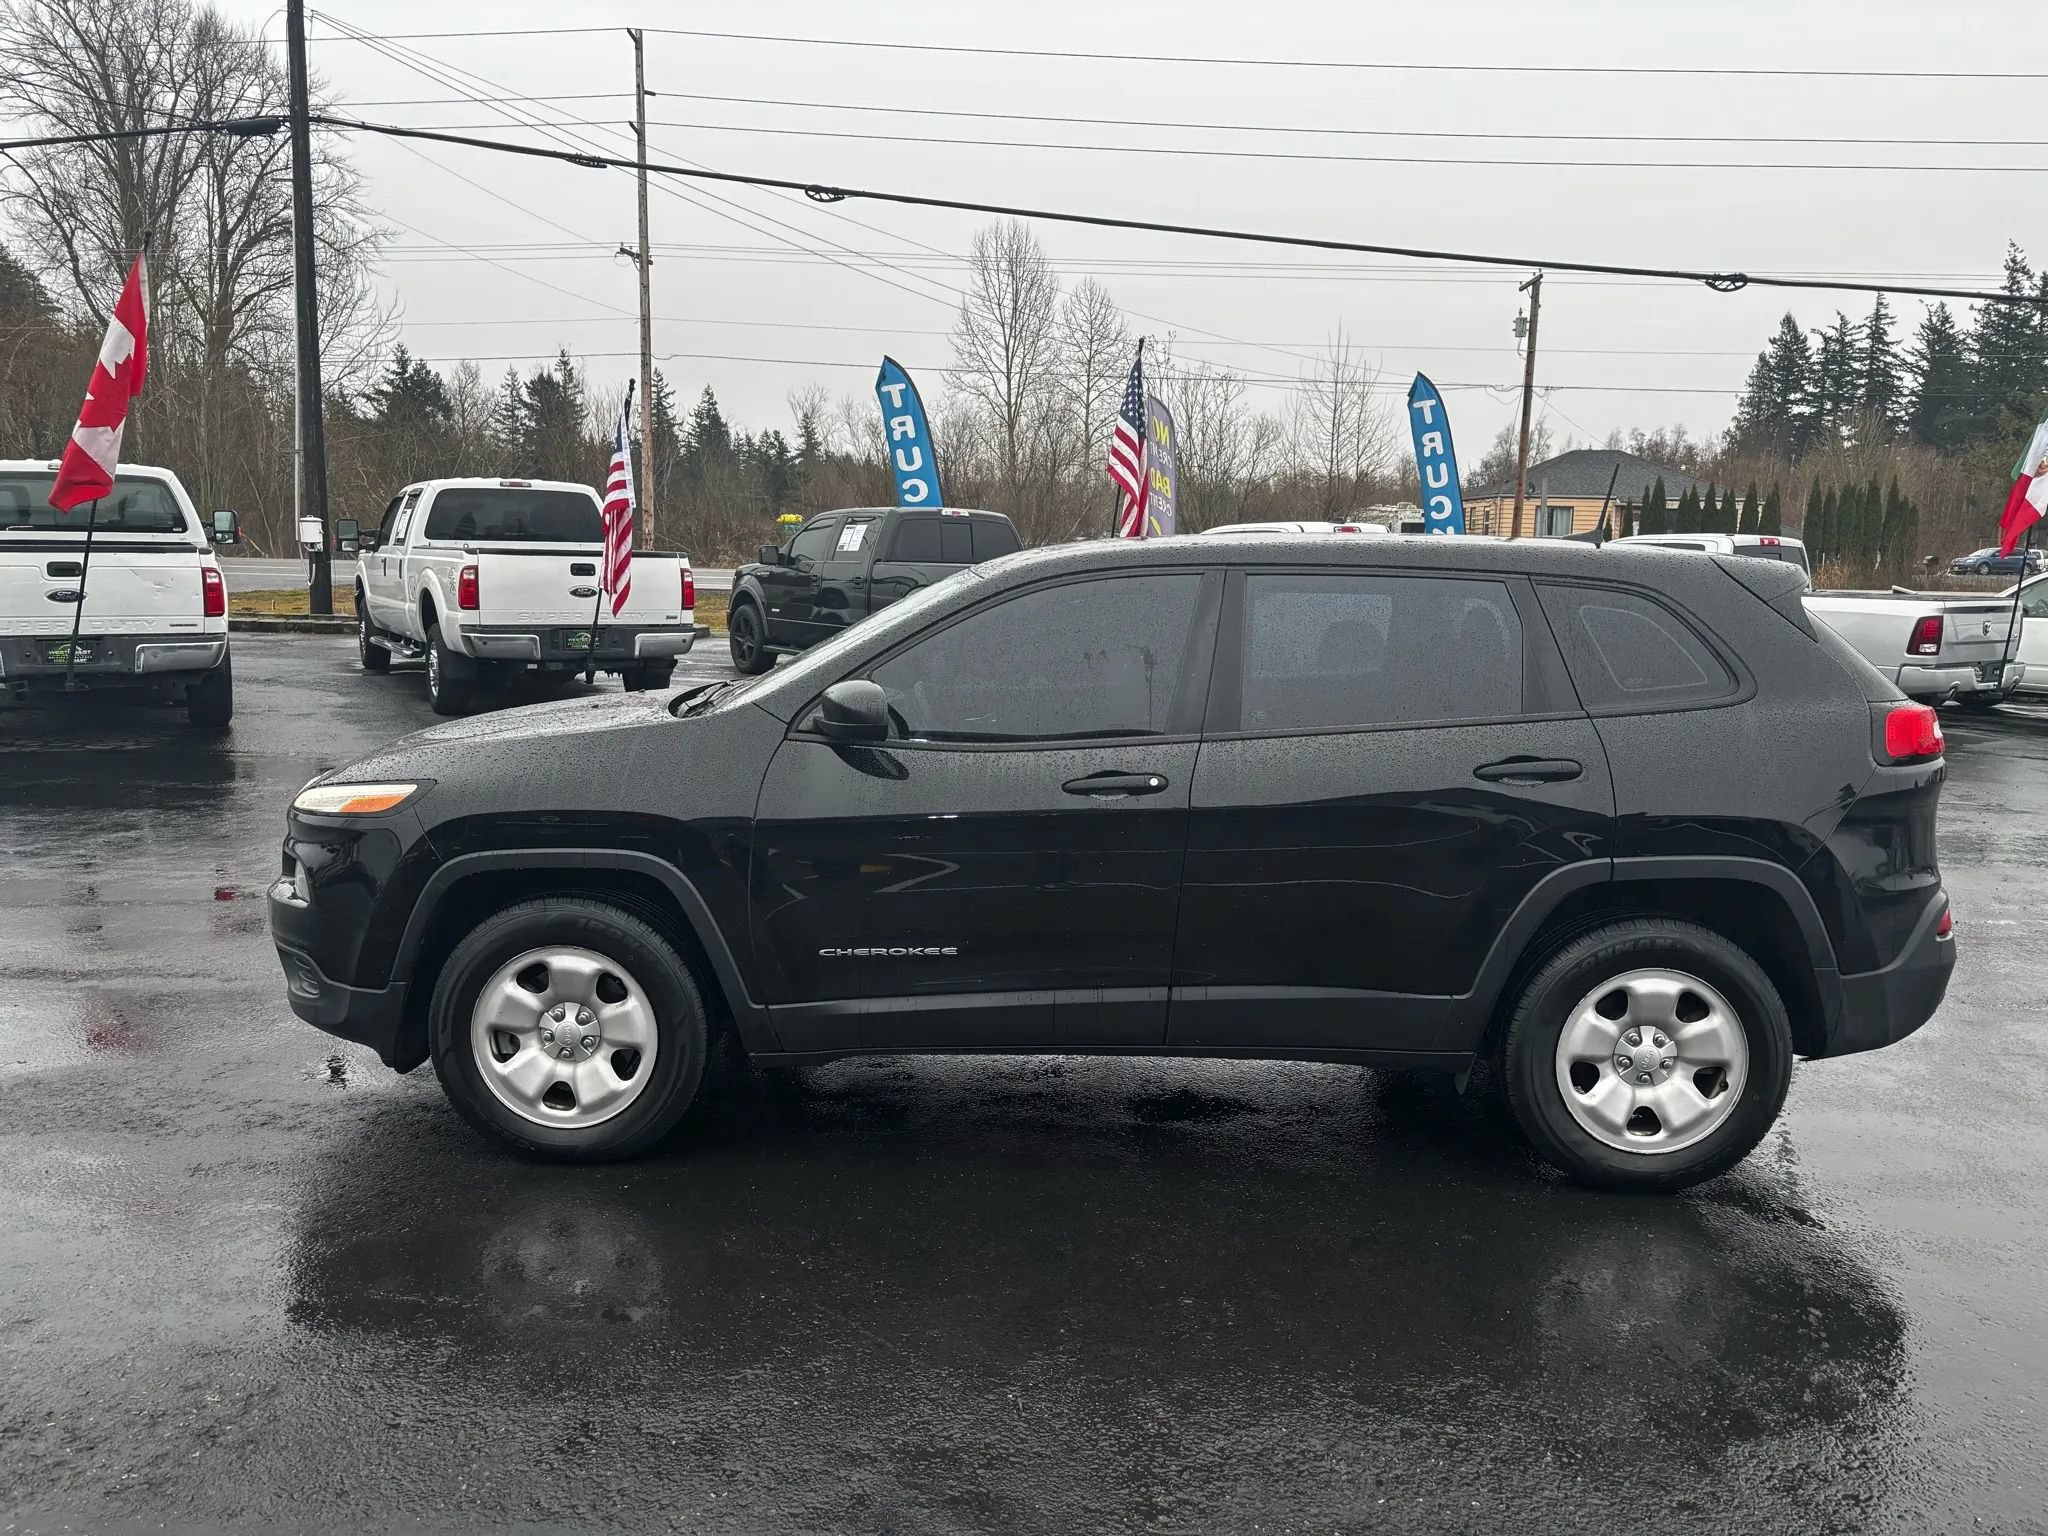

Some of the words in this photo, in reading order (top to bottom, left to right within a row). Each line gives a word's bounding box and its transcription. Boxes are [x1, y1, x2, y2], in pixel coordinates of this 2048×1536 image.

[517, 611, 585, 622] SUPER
[88, 619, 157, 632] DUTY
[818, 947, 958, 956] CHEROKEE
